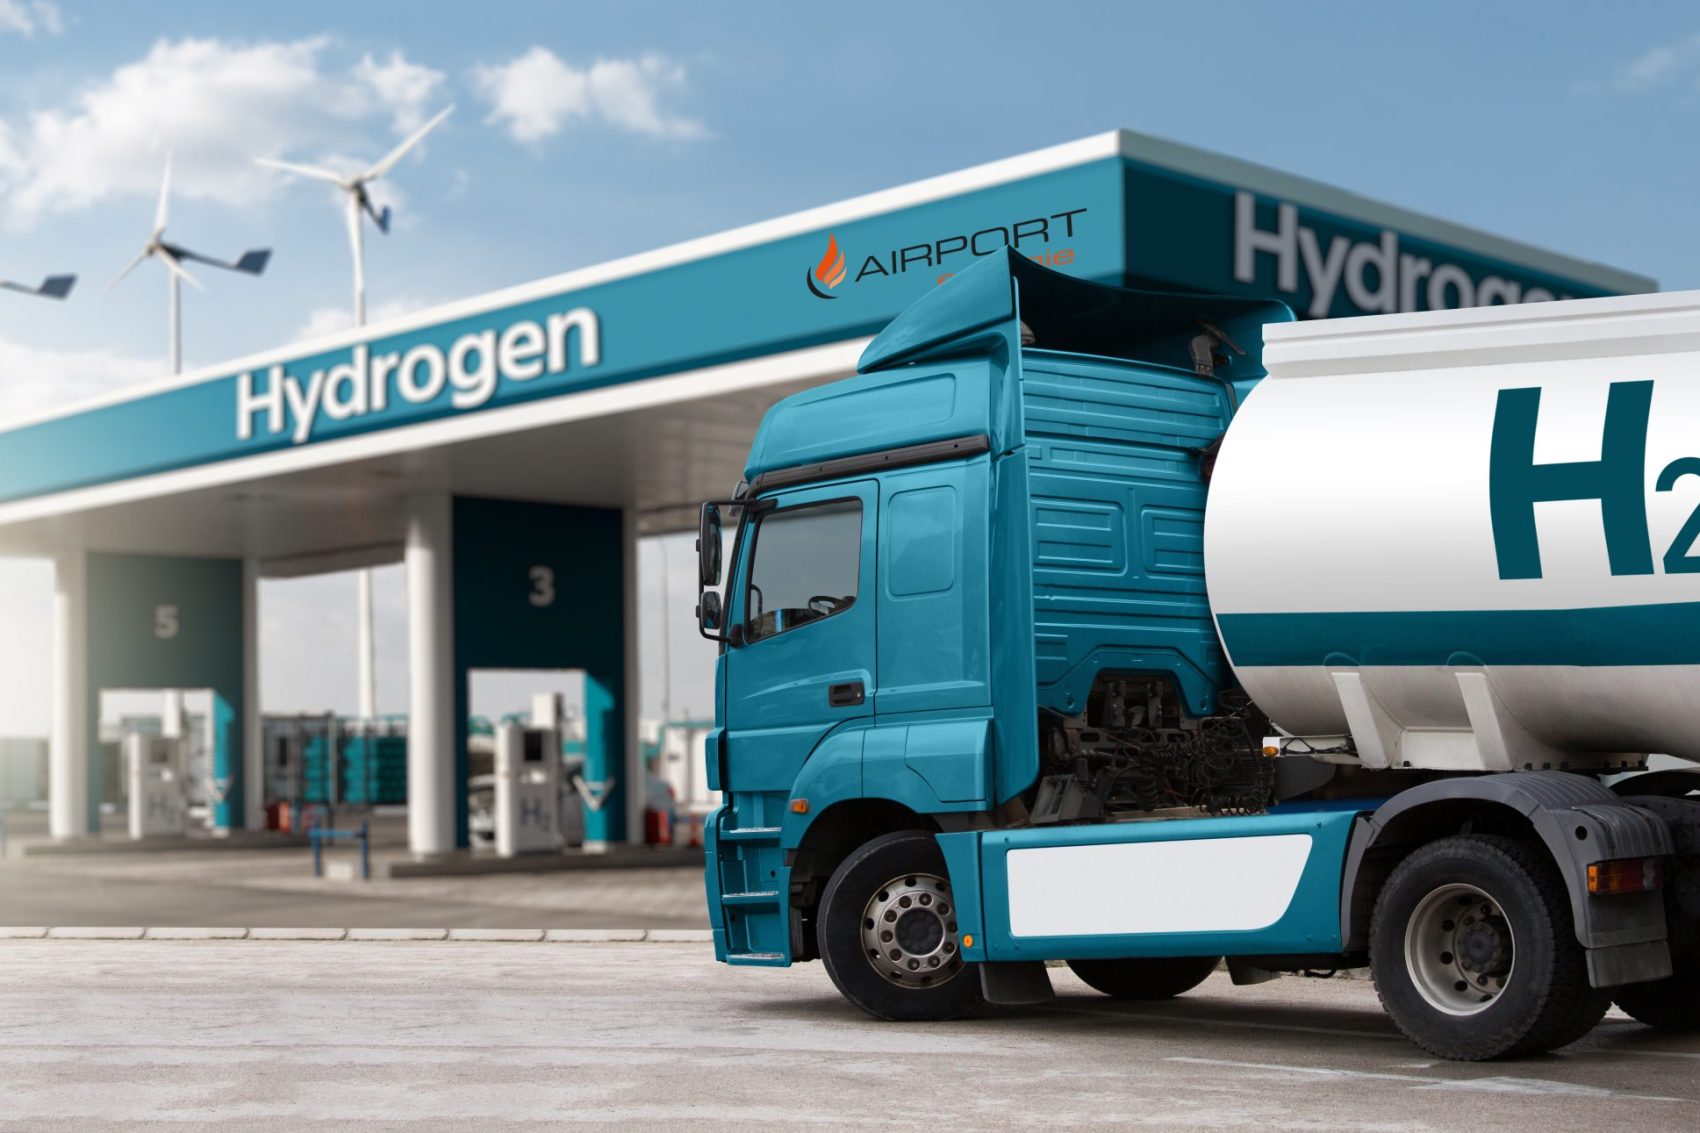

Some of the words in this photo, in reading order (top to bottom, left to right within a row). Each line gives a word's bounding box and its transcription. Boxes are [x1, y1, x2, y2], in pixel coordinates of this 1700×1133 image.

[855, 207, 1088, 283] AIRPORT
[1234, 191, 1575, 318] Hydro
[236, 307, 600, 443] Hydrogen
[155, 604, 179, 639] 5
[528, 566, 555, 607] 3
